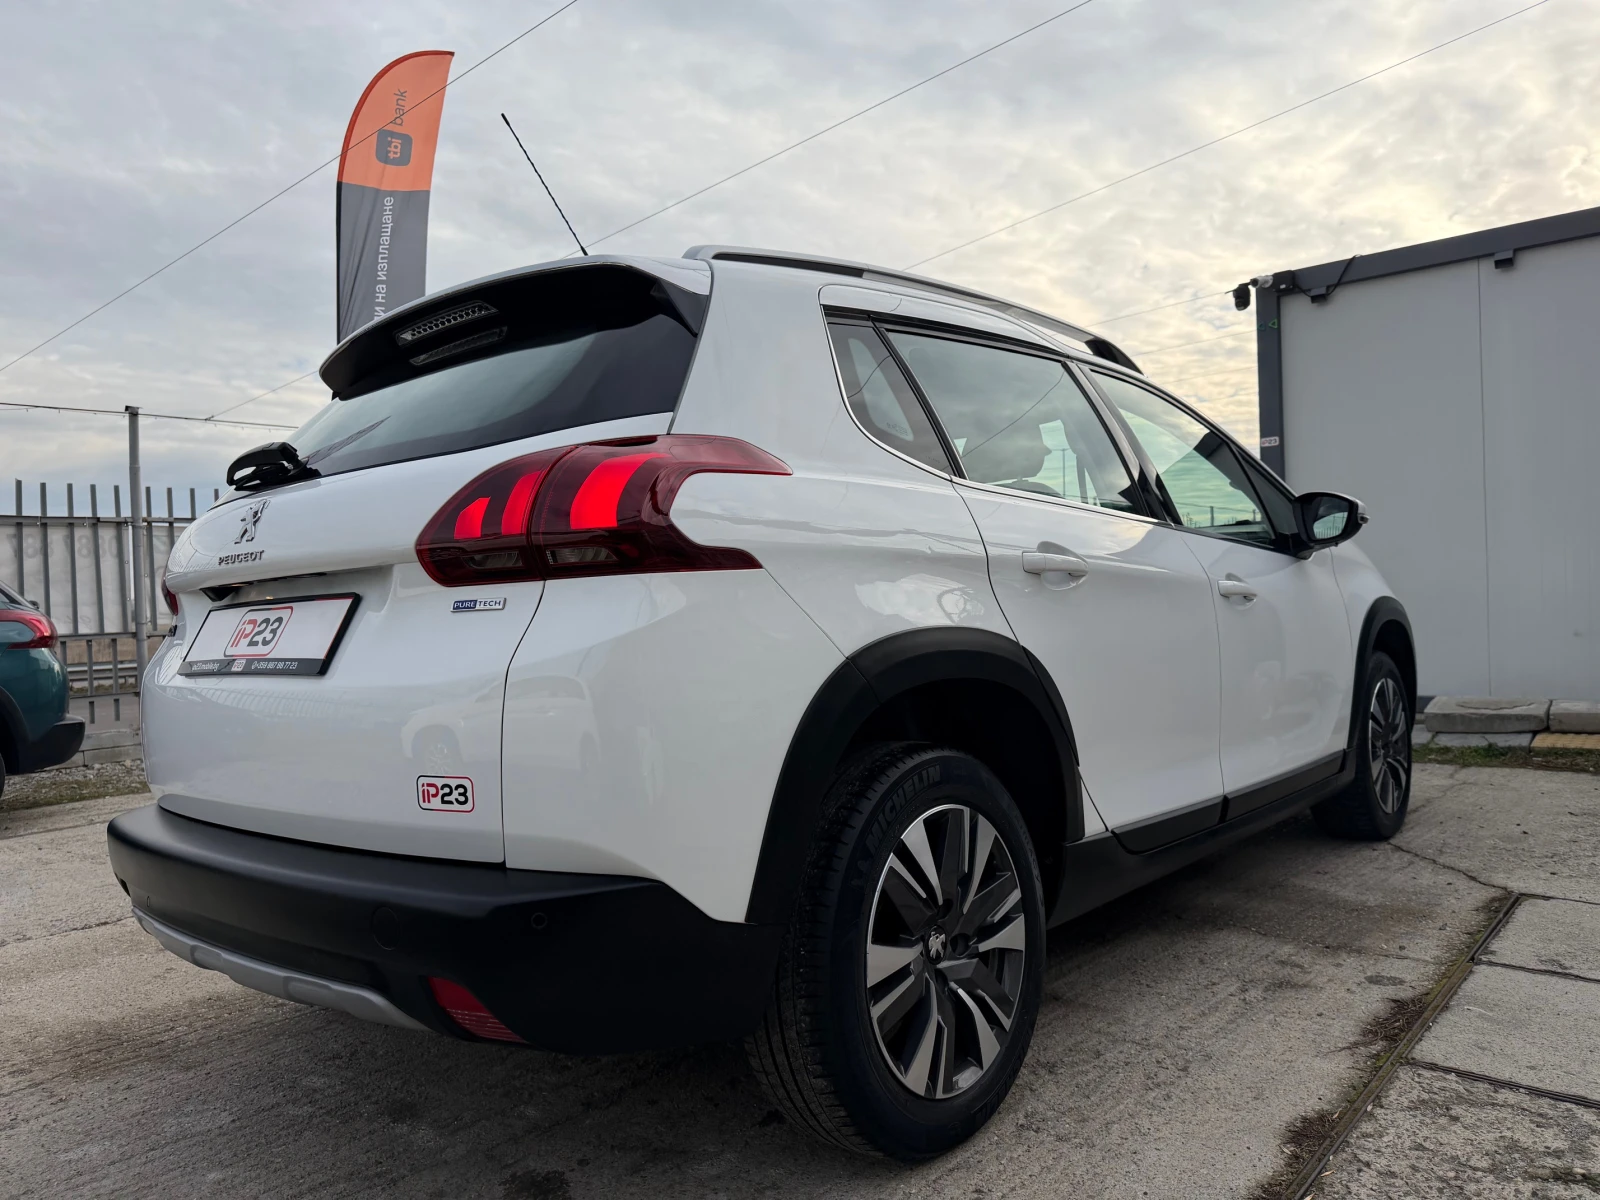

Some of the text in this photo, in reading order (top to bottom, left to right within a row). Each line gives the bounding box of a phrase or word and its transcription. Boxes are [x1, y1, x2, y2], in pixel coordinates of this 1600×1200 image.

[387, 88, 408, 159] tbi bank
[377, 196, 394, 280] изплащане
[375, 284, 387, 302] на
[217, 550, 265, 566] PEUGEOT
[865, 764, 941, 856] MICHELIN
